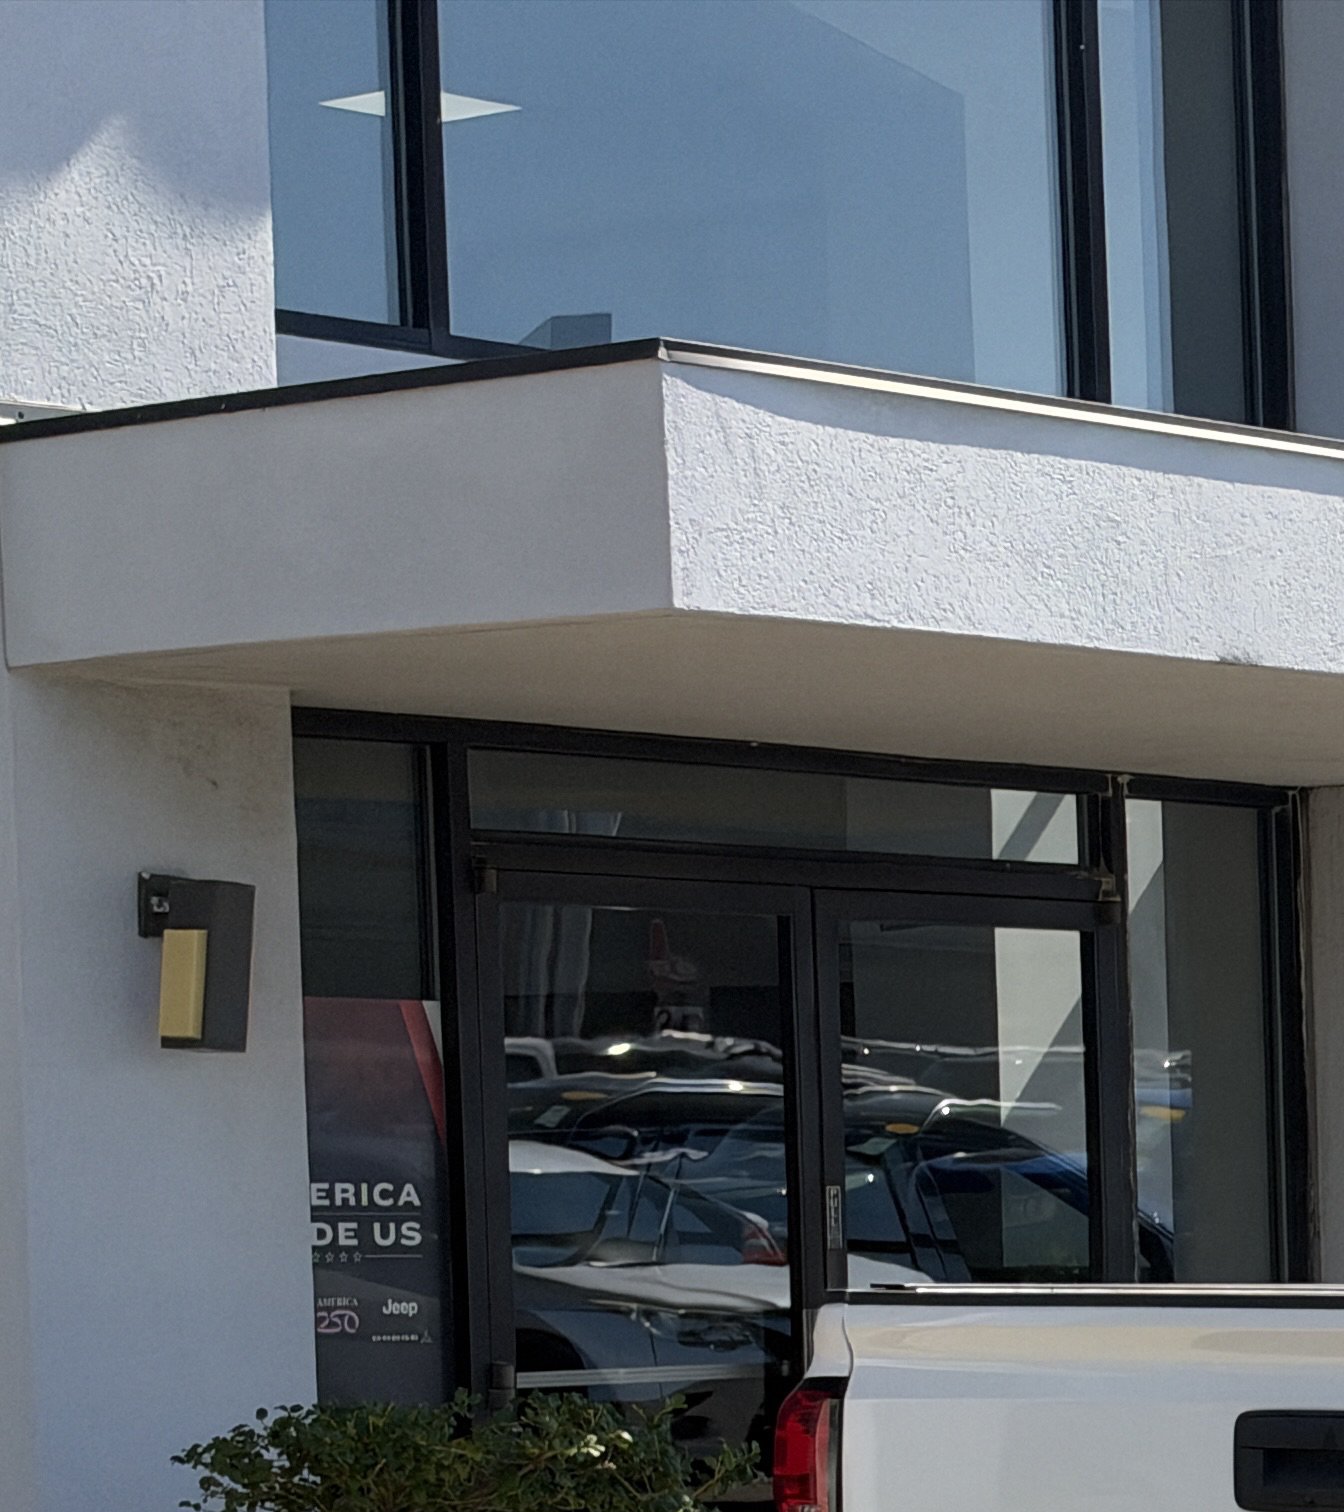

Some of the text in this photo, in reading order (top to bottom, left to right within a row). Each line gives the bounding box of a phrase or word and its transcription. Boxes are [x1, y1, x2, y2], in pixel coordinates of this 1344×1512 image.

[310, 1182, 421, 1207] ERICA
[310, 1222, 423, 1247] DE US
[382, 1298, 418, 1317] Jeep
[316, 1309, 360, 1334] 250
